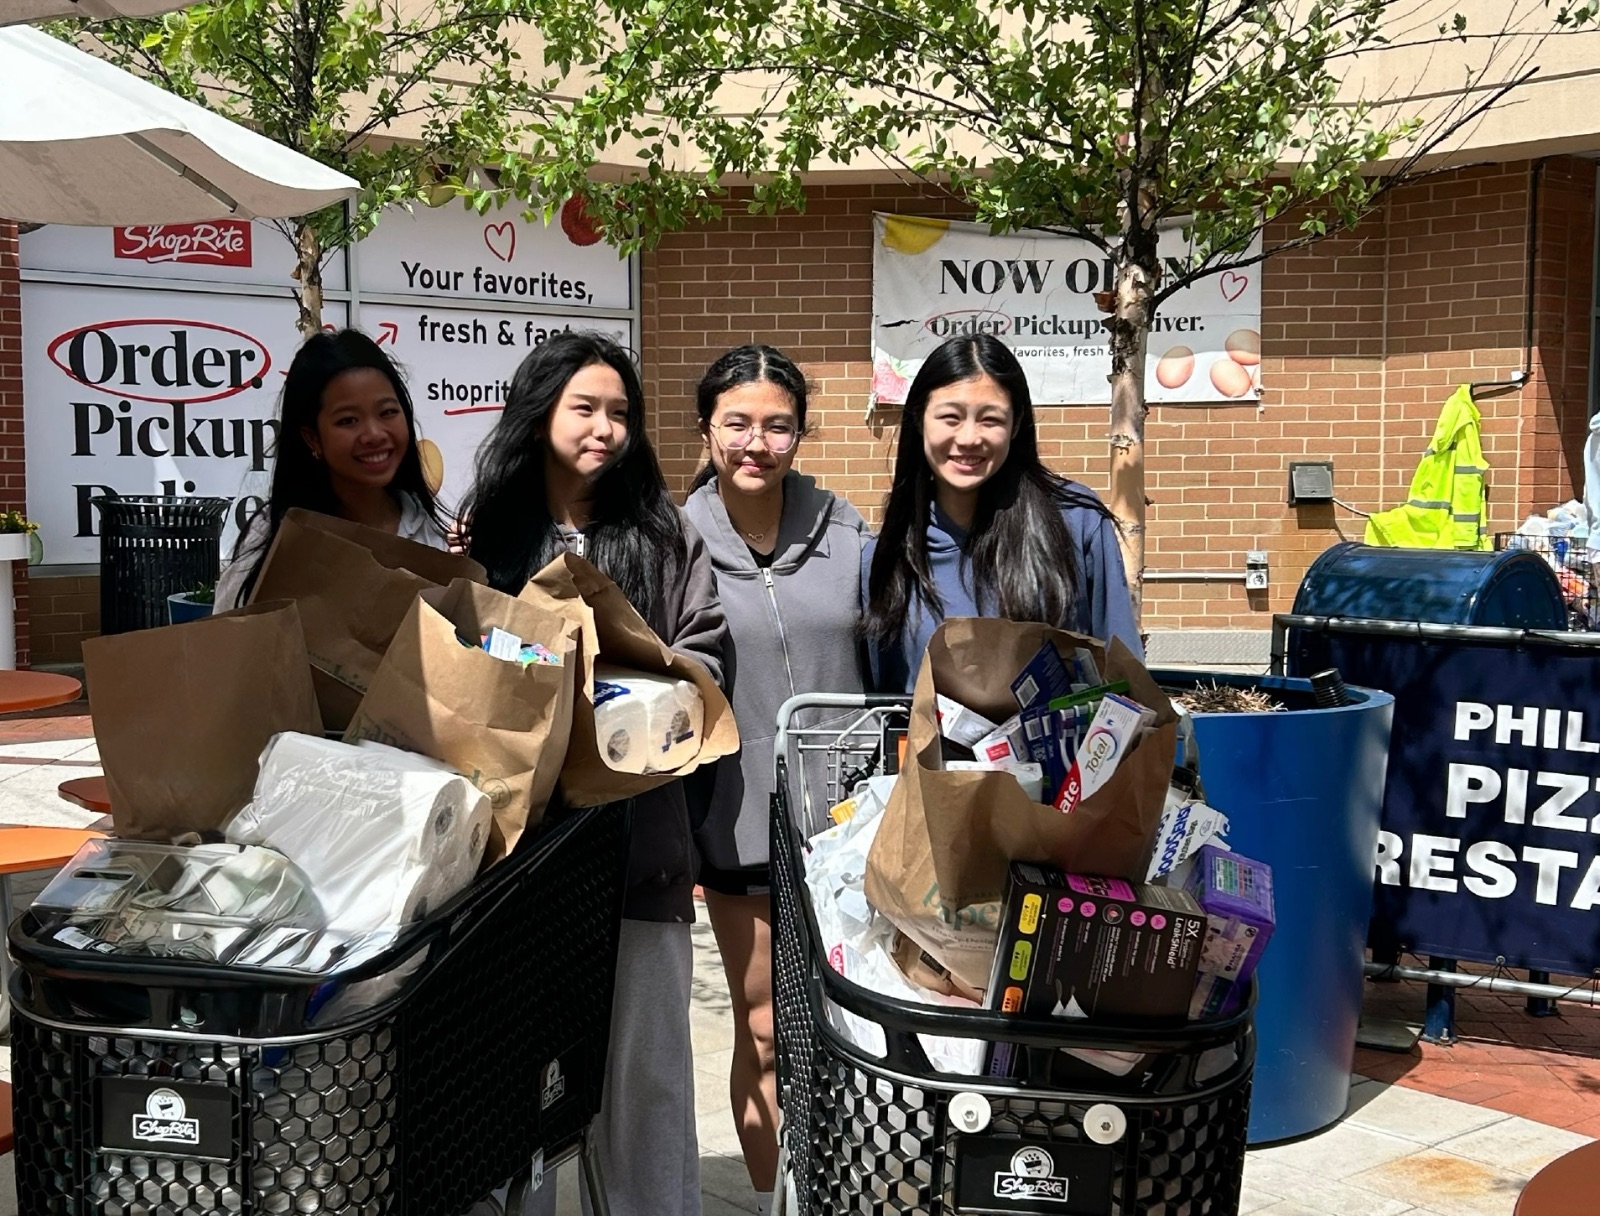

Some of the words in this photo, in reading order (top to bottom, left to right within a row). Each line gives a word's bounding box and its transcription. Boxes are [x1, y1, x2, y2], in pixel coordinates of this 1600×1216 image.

[121, 223, 246, 261] ShopRite
[401, 261, 464, 291] Your
[473, 267, 594, 304] favorites,
[938, 259, 1055, 295] NOW
[1065, 257, 1194, 295] ON
[418, 315, 487, 345] fresh
[497, 320, 516, 346] &
[525, 321, 572, 347] fa
[930, 315, 1008, 337] Order.
[1013, 314, 1106, 340] Pickup.
[1149, 312, 1205, 333] iver.
[69, 328, 263, 389] Order.
[1013, 346, 1070, 359] favorites,
[1073, 345, 1105, 357] fresh
[69, 400, 281, 471] Pickup
[1454, 701, 1600, 753] PHIL
[1085, 737, 1108, 773] Total
[1446, 762, 1600, 834] PIZ
[1157, 804, 1193, 875] OODSENS
[1185, 919, 1202, 939] 5X
[137, 1119, 196, 1139] ShopRite
[999, 1177, 1064, 1197] ShopRite
